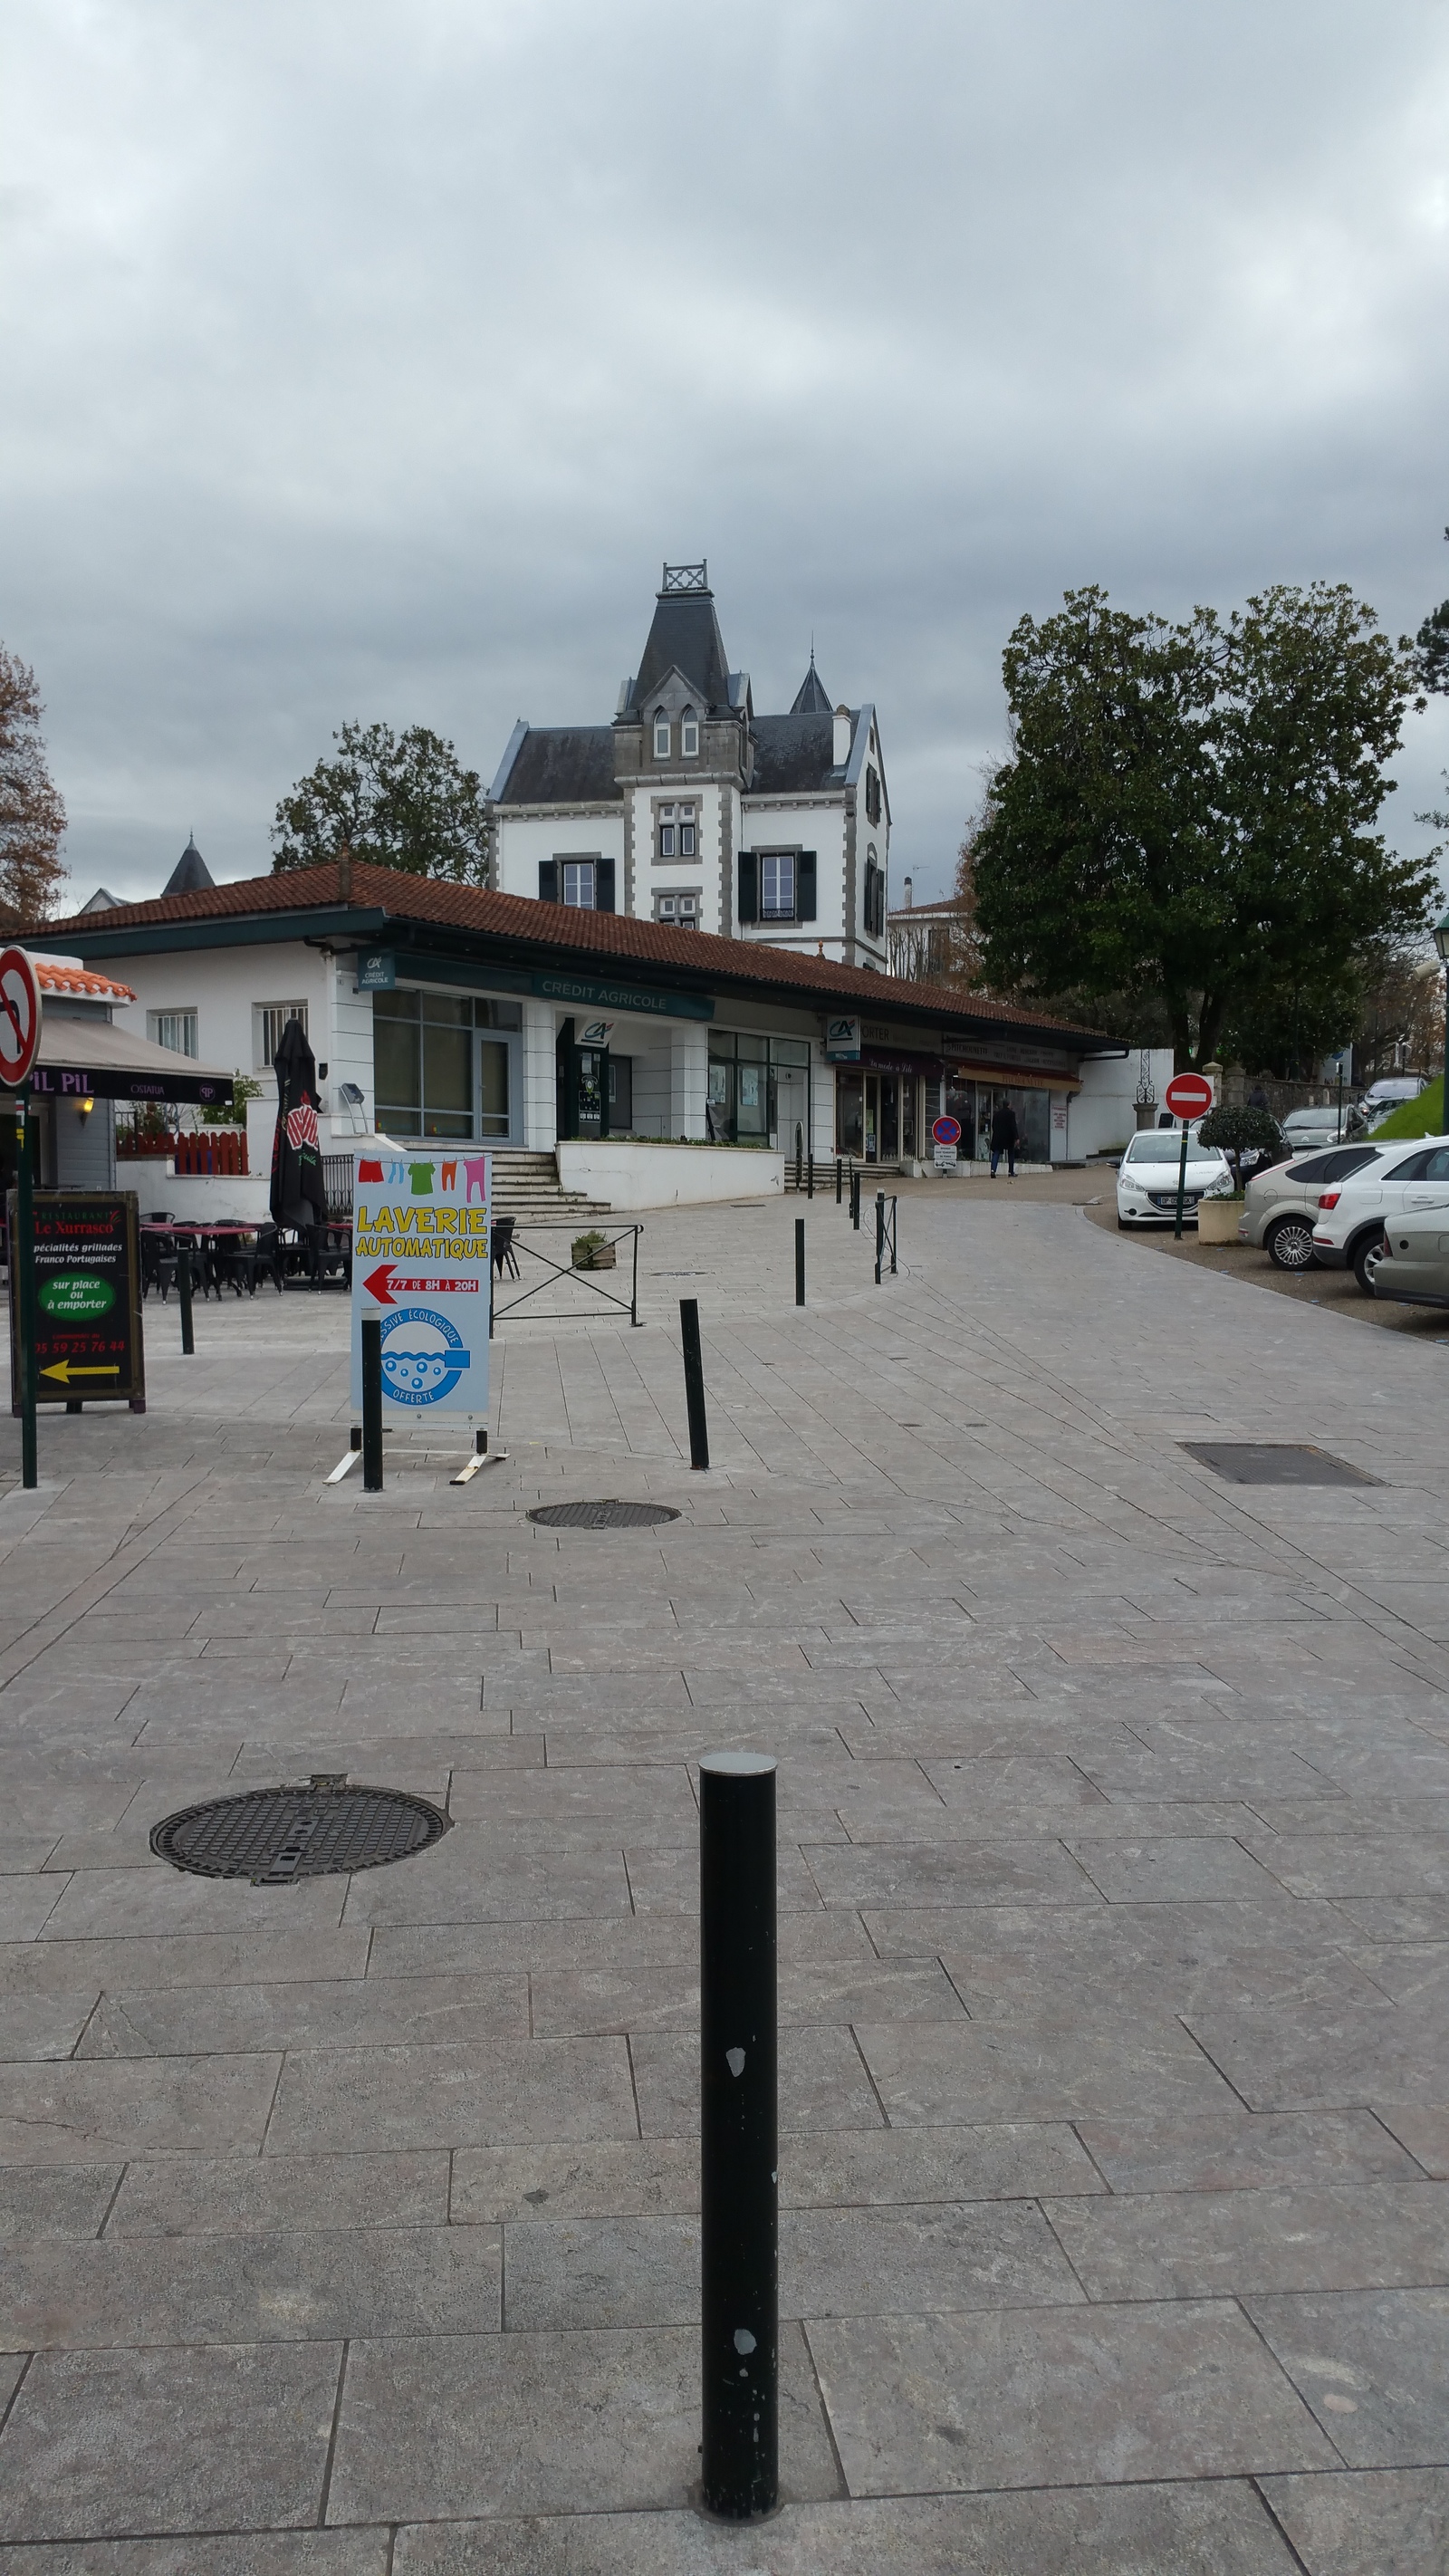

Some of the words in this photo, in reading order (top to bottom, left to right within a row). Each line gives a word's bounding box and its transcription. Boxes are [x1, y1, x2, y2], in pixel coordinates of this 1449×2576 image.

[361, 976, 389, 985] AGRICOLE
[542, 980, 595, 999] CRÉDIT
[598, 990, 667, 1010] AGRICOLE
[860, 1027, 889, 1041] ORTER
[42, 1211, 109, 1221] RESTAURANT
[357, 1206, 487, 1235] LAVERIE
[34, 1222, 52, 1235] Le
[55, 1222, 114, 1235] Xurrasco
[33, 1243, 79, 1254] pécialités
[82, 1243, 123, 1254] grillades
[356, 1236, 488, 1261] AUTOMATIQUE
[34, 1254, 65, 1264] Franco
[66, 1254, 117, 1264] Portugaises
[53, 1281, 71, 1290] sur
[72, 1280, 101, 1291] place
[387, 1280, 408, 1290] 7/7
[412, 1280, 421, 1290] DE
[426, 1280, 440, 1291] 8H
[445, 1279, 451, 1291] À
[455, 1281, 476, 1291] 20H
[70, 1291, 83, 1299] ou
[47, 1300, 54, 1310] à
[57, 1300, 107, 1311] emporter
[408, 1309, 459, 1344] ÉCOLOGIQUE
[51, 1341, 68, 1354] 59
[71, 1341, 87, 1353] 25
[91, 1341, 106, 1352] 76
[110, 1341, 125, 1351] 44
[392, 1389, 435, 1404] OFFERTE
